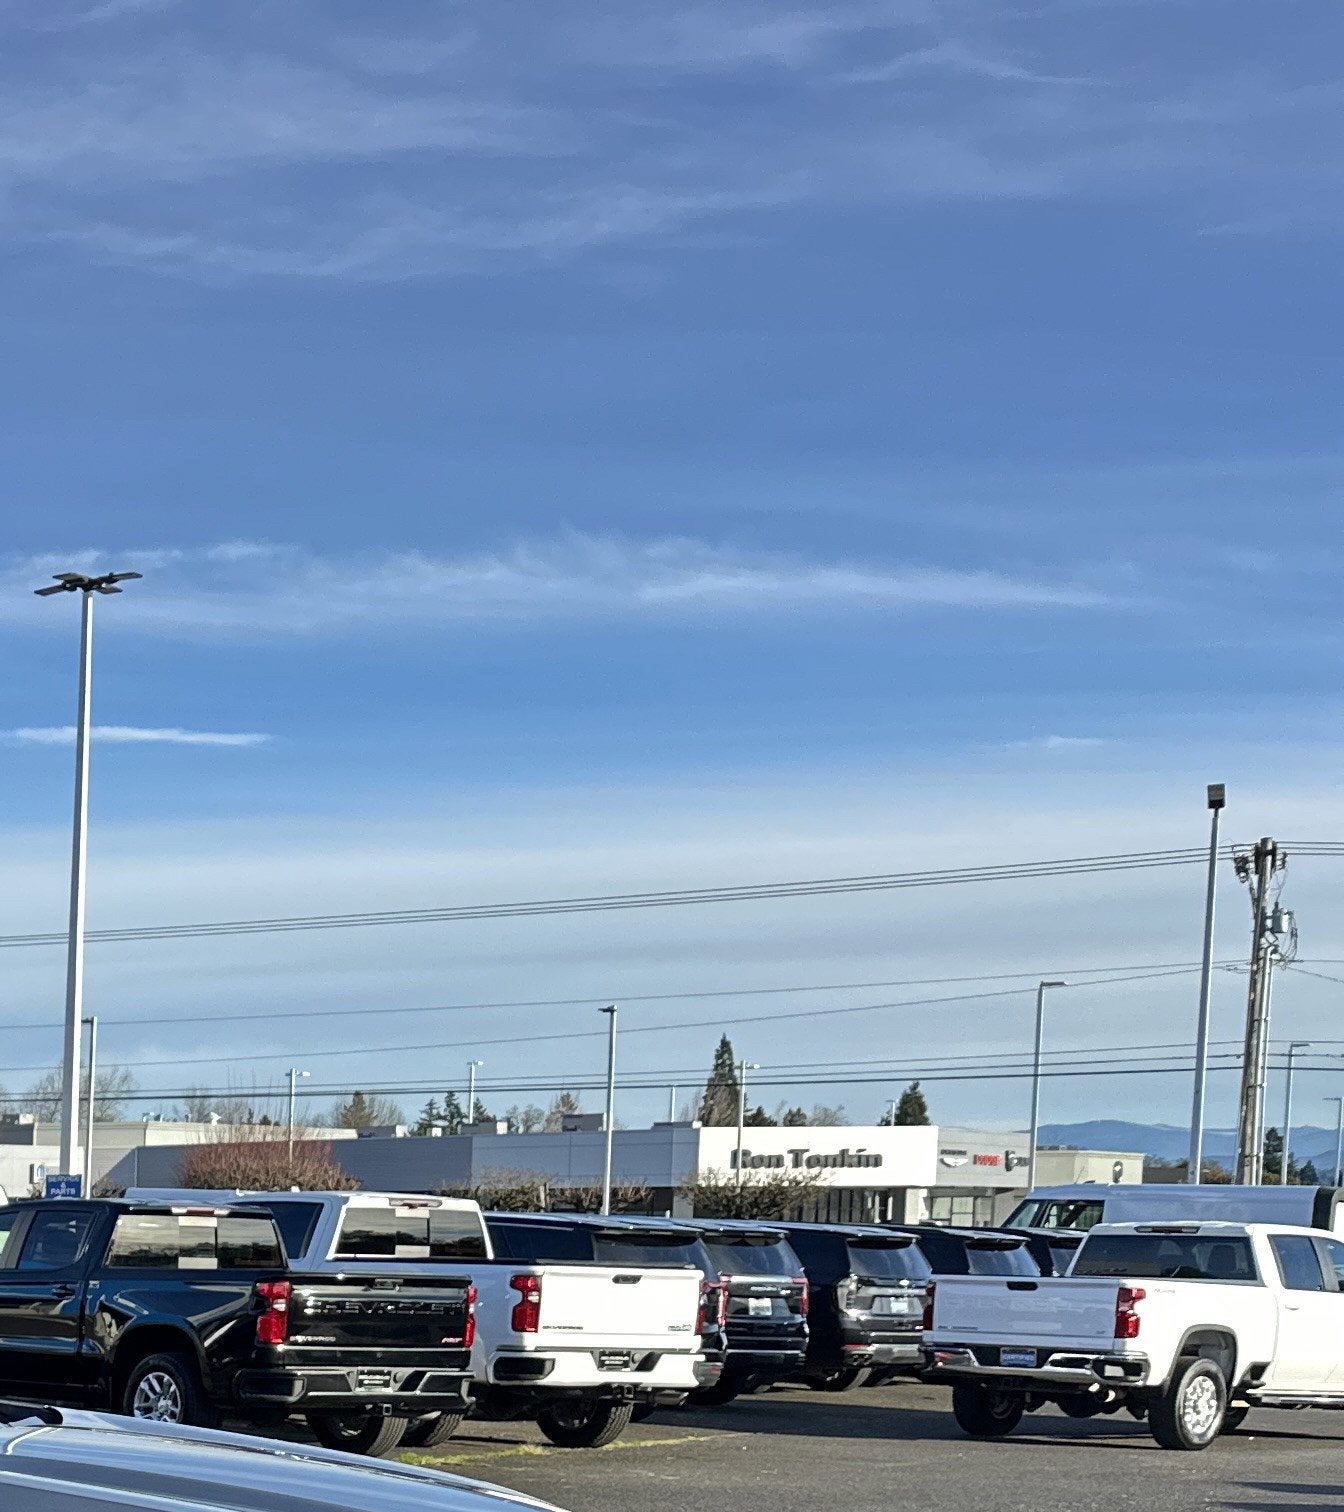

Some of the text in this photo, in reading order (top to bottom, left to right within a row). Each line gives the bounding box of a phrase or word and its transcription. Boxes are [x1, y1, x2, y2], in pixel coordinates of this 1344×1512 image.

[729, 1148, 883, 1169] Ron Tonkin
[50, 1187, 76, 1195] PARTS
